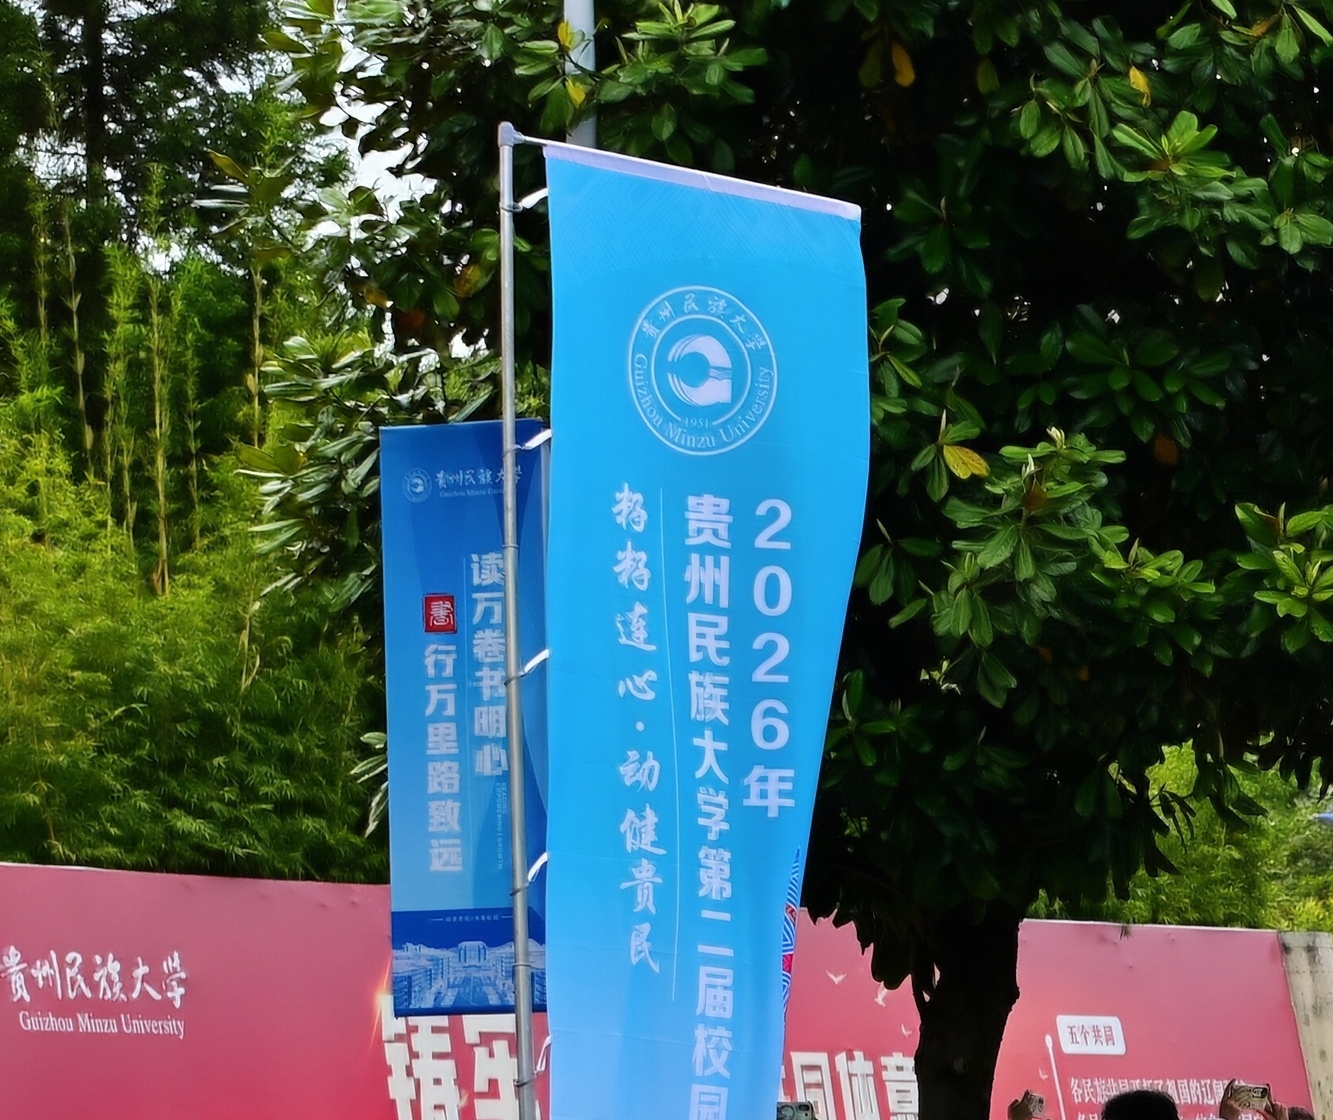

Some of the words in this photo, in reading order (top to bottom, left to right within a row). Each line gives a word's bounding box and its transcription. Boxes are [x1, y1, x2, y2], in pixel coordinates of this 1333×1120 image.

[634, 353, 663, 428] Guizhou
[664, 421, 717, 449] Minzu
[718, 366, 775, 444] University
[684, 416, 709, 429] 1951
[470, 552, 509, 777] 读万卷书明心
[742, 498, 797, 818] 2026年
[424, 644, 463, 872] 行万里路致远
[19, 1010, 74, 1032] Guizhou
[76, 1012, 118, 1034] Minzu
[120, 1013, 185, 1040] University
